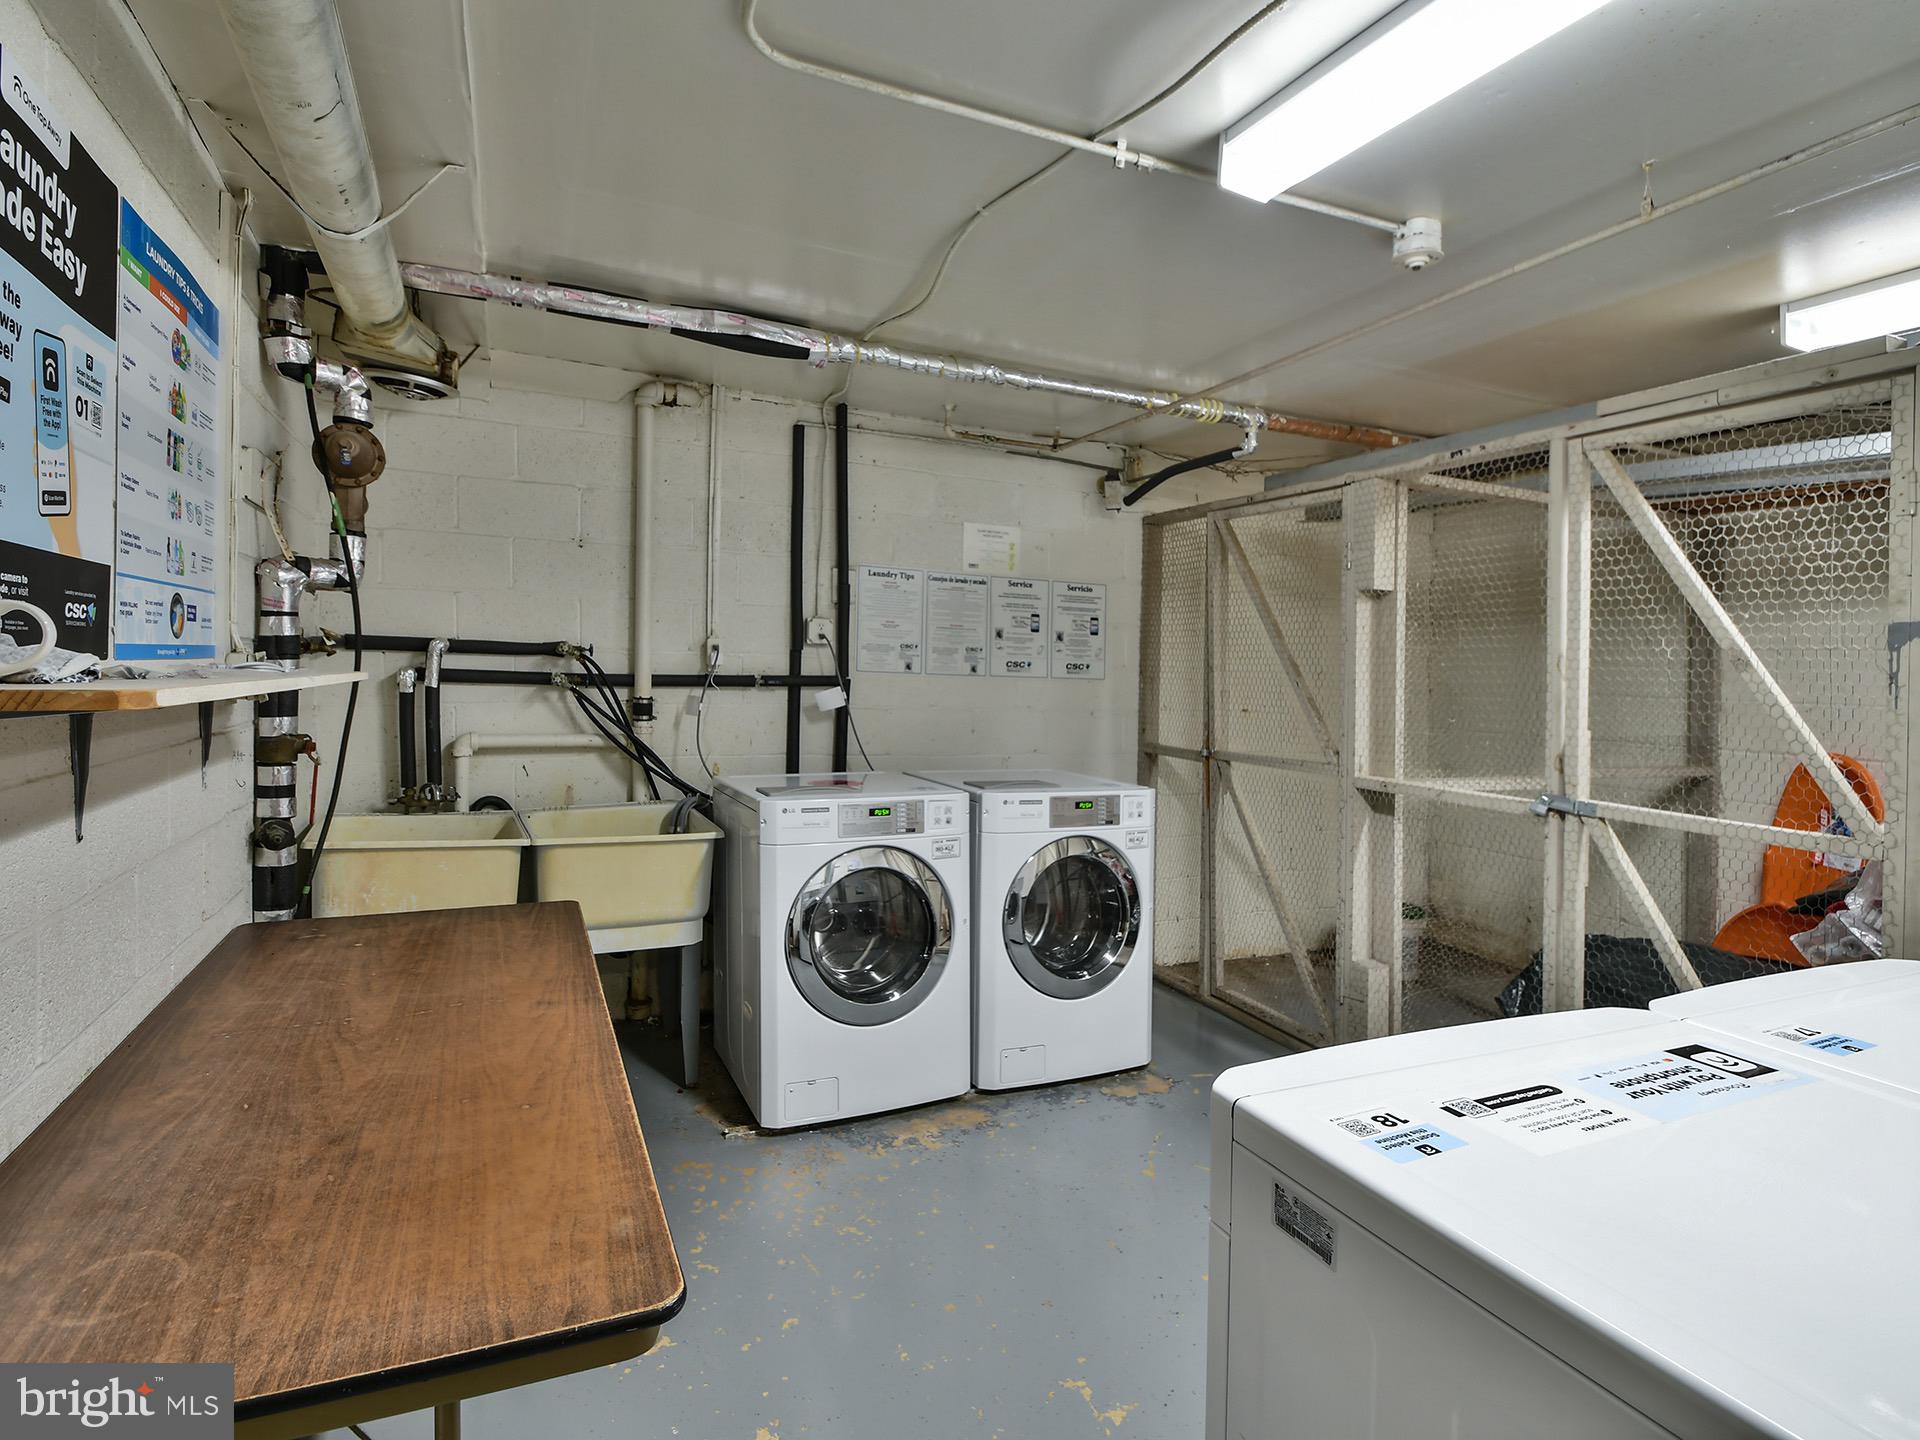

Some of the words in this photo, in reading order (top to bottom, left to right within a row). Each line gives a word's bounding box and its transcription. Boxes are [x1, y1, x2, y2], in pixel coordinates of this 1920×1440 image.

[41, 213, 87, 296] Easy
[146, 242, 175, 279] LAUNDRY
[3, 280, 21, 309] the
[75, 395, 88, 421] 01
[22, 575, 28, 584] to
[868, 569, 898, 580] Laundry
[899, 572, 915, 580] Tips
[11, 586, 17, 595] or
[18, 586, 29, 597] visit
[1008, 580, 1033, 589] Service
[1067, 584, 1093, 593] Servicio
[65, 602, 87, 619] CSC
[1794, 1027, 1822, 1037] 17
[1609, 1065, 1703, 1089] Smartphone
[1689, 1072, 1727, 1084] Pay
[1659, 1080, 1692, 1092] with
[1625, 1086, 1670, 1100] Your
[1370, 1113, 1410, 1127] 18
[1374, 1132, 1412, 1144] Machine
[1419, 1132, 1440, 1141] Scan
[1381, 1140, 1411, 1150] Select
